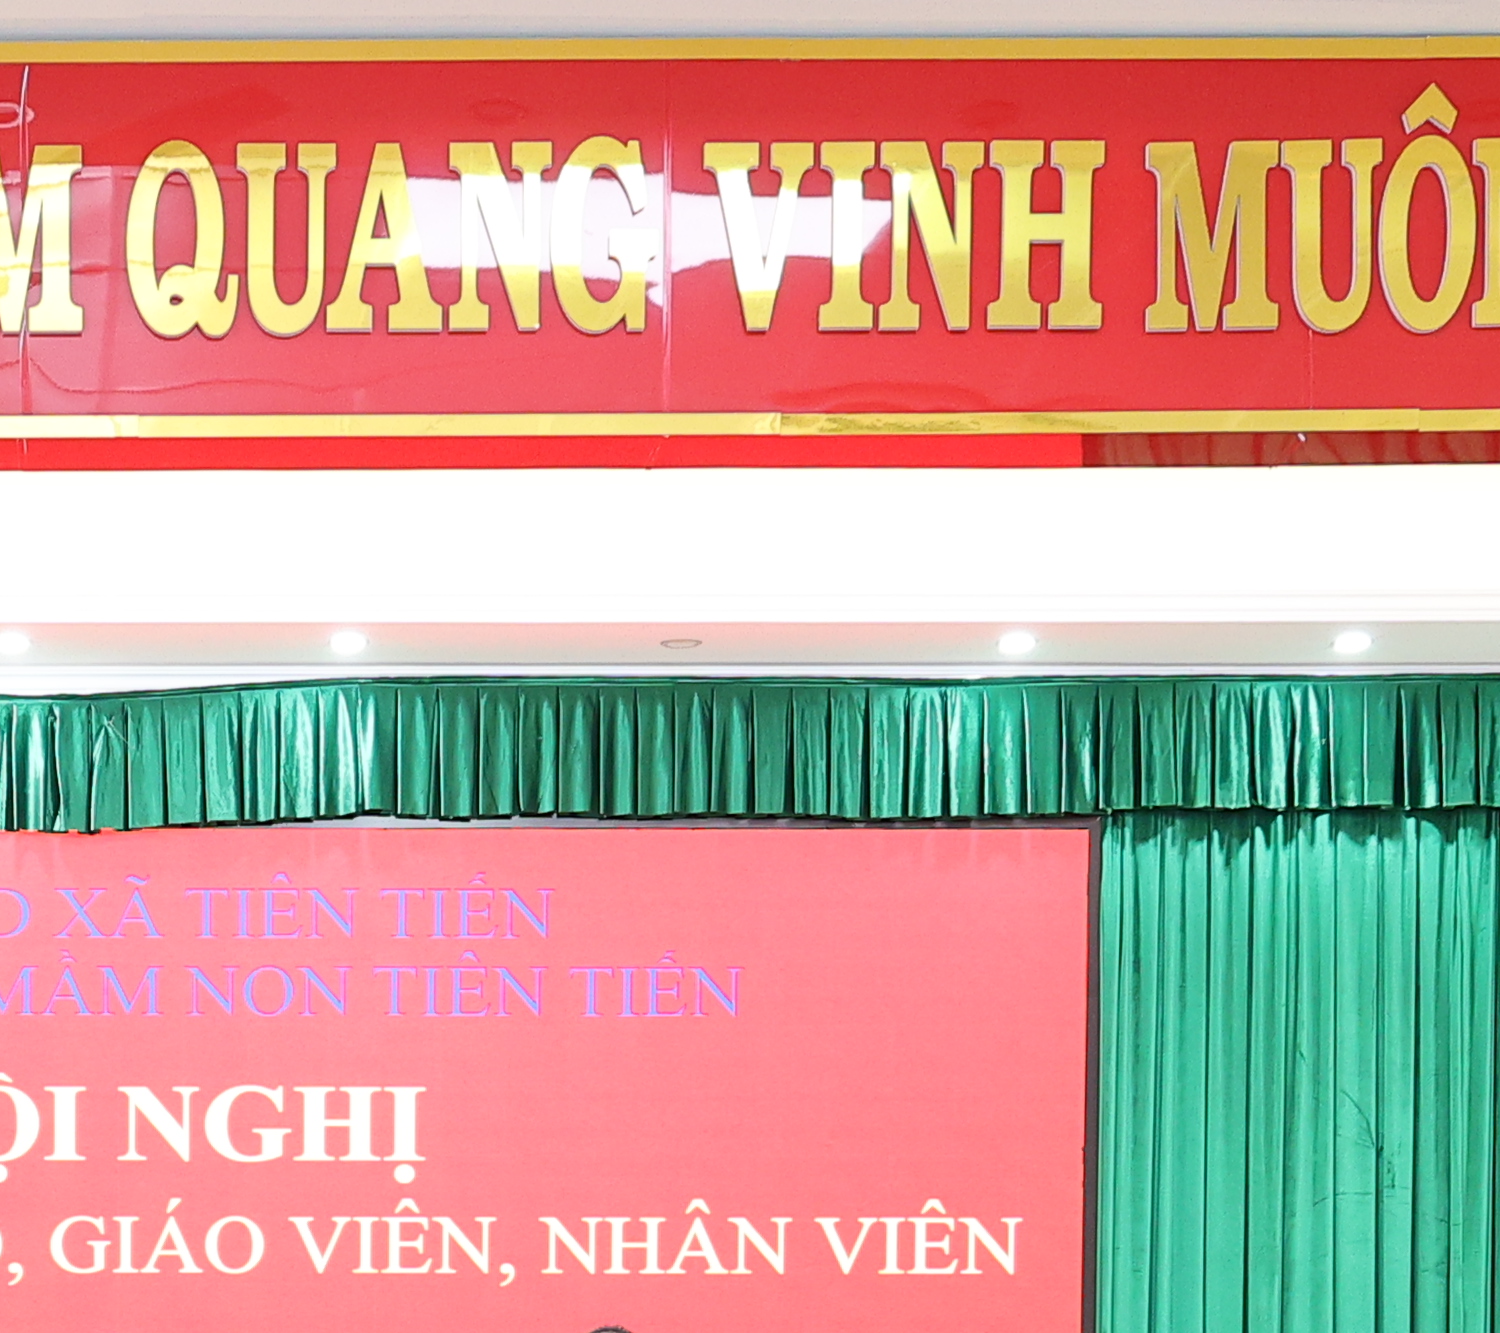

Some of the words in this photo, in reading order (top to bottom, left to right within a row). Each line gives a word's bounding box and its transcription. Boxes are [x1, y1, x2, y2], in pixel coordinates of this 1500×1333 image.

[124, 134, 657, 340] QUANG
[699, 139, 1106, 331] VINH
[53, 873, 163, 941] XÃ
[184, 871, 360, 941] TIÊN
[380, 871, 556, 941] TIẾN
[186, 963, 352, 1018] NON
[374, 950, 549, 1018] TIÊN
[569, 947, 745, 1018] TIẾN
[117, 1084, 427, 1184] NGHỊ
[49, 1197, 265, 1275] GIÁO
[288, 1198, 516, 1287] VIÊN,
[538, 1198, 793, 1275] NHÂN
[814, 1198, 1023, 1275] VIÊN
